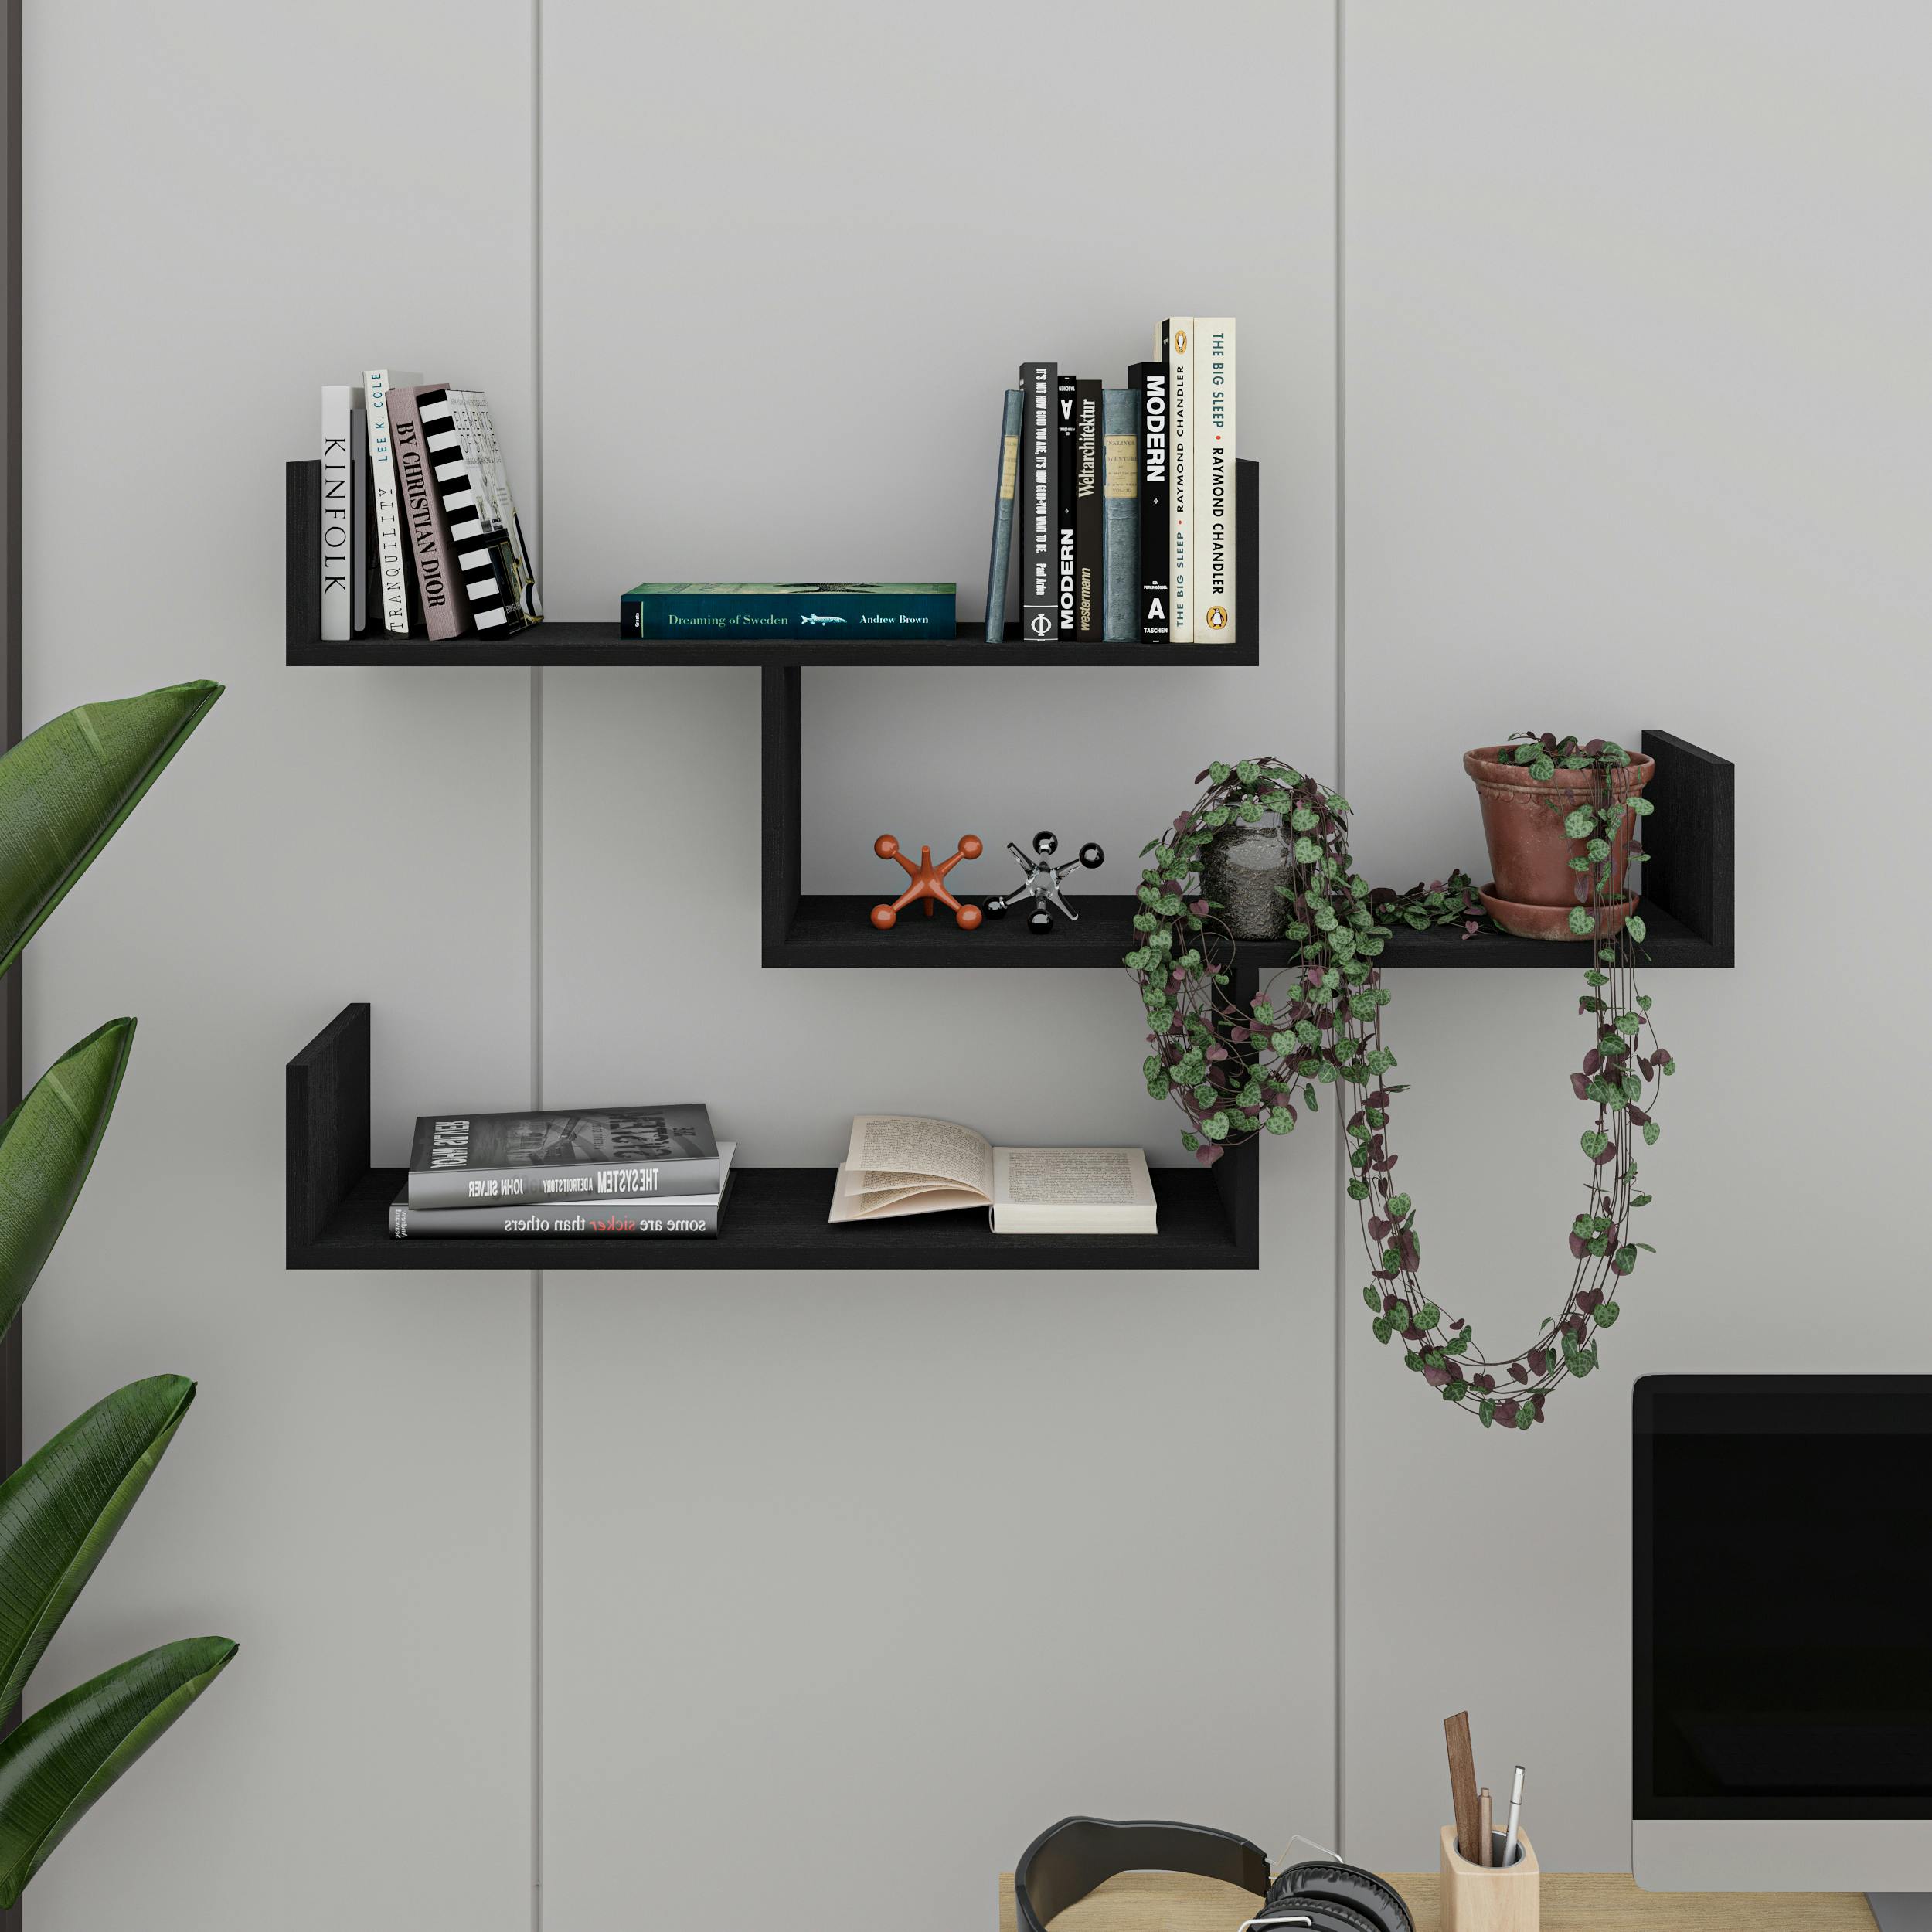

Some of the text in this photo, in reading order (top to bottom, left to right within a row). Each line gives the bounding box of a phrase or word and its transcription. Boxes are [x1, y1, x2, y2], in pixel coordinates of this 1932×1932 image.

[372, 373, 384, 408] COLE
[1036, 382, 1047, 394] NOT
[1036, 395, 1047, 409] HOW
[1061, 399, 1073, 420] A
[1036, 410, 1047, 427] GOOD
[1146, 376, 1165, 482] MODERN
[1036, 427, 1047, 440] YOU
[376, 437, 388, 462] LEE
[1078, 398, 1096, 498] Weltarchitektur
[1213, 332, 1224, 594] THE BIG SLEEP RAYMOND CHANDLER
[1036, 470, 1047, 484] HOW
[324, 437, 347, 594] KINFOLK
[396, 421, 446, 609] BY CHRISTIAN DIOR
[1036, 515, 1047, 533] WANT
[1036, 534, 1047, 543] TO
[379, 488, 403, 631] TRANQUILITY
[1036, 563, 1047, 577] Paul
[1060, 529, 1074, 629] MODERN
[1080, 567, 1091, 631] westermann
[1147, 597, 1165, 620] A
[668, 614, 788, 628] Dreaming of Sweden
[859, 614, 929, 624] Andrew Brown
